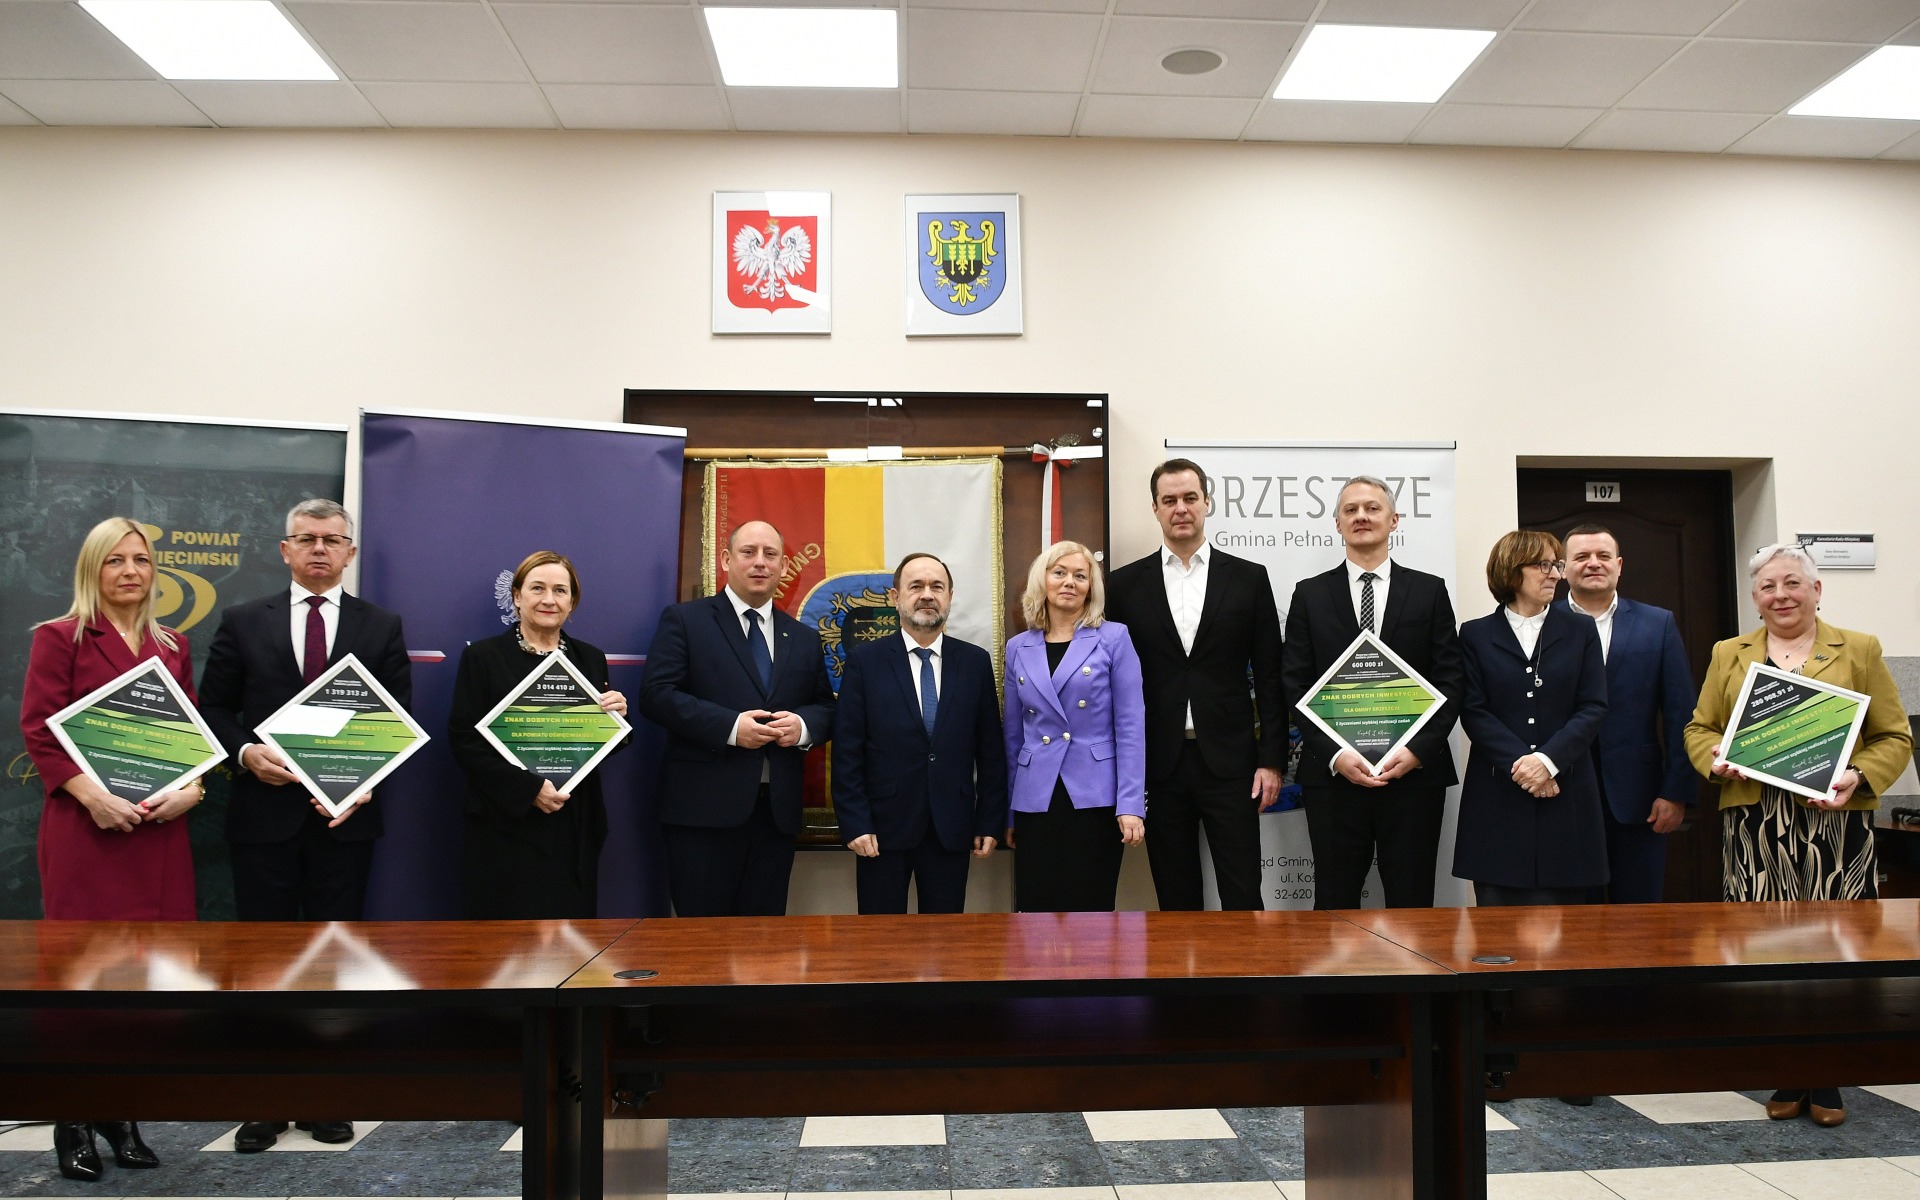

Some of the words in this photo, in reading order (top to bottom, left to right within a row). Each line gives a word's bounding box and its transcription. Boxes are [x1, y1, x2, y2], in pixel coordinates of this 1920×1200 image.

[1593, 485, 1614, 498] 107
[171, 531, 240, 546] POWIAT
[1215, 530, 1276, 547] Gmina
[1284, 530, 1333, 547] Pełna
[85, 718, 108, 727] ZNAK
[111, 722, 143, 734] DOBREJ
[1740, 736, 1760, 747] ZNAK
[1761, 723, 1790, 738] DOBREJ
[1791, 704, 1835, 725] INWESTYCJI
[1278, 856, 1314, 869] Gminy
[1281, 873, 1294, 883] ul.
[1275, 889, 1313, 899] 32-620
